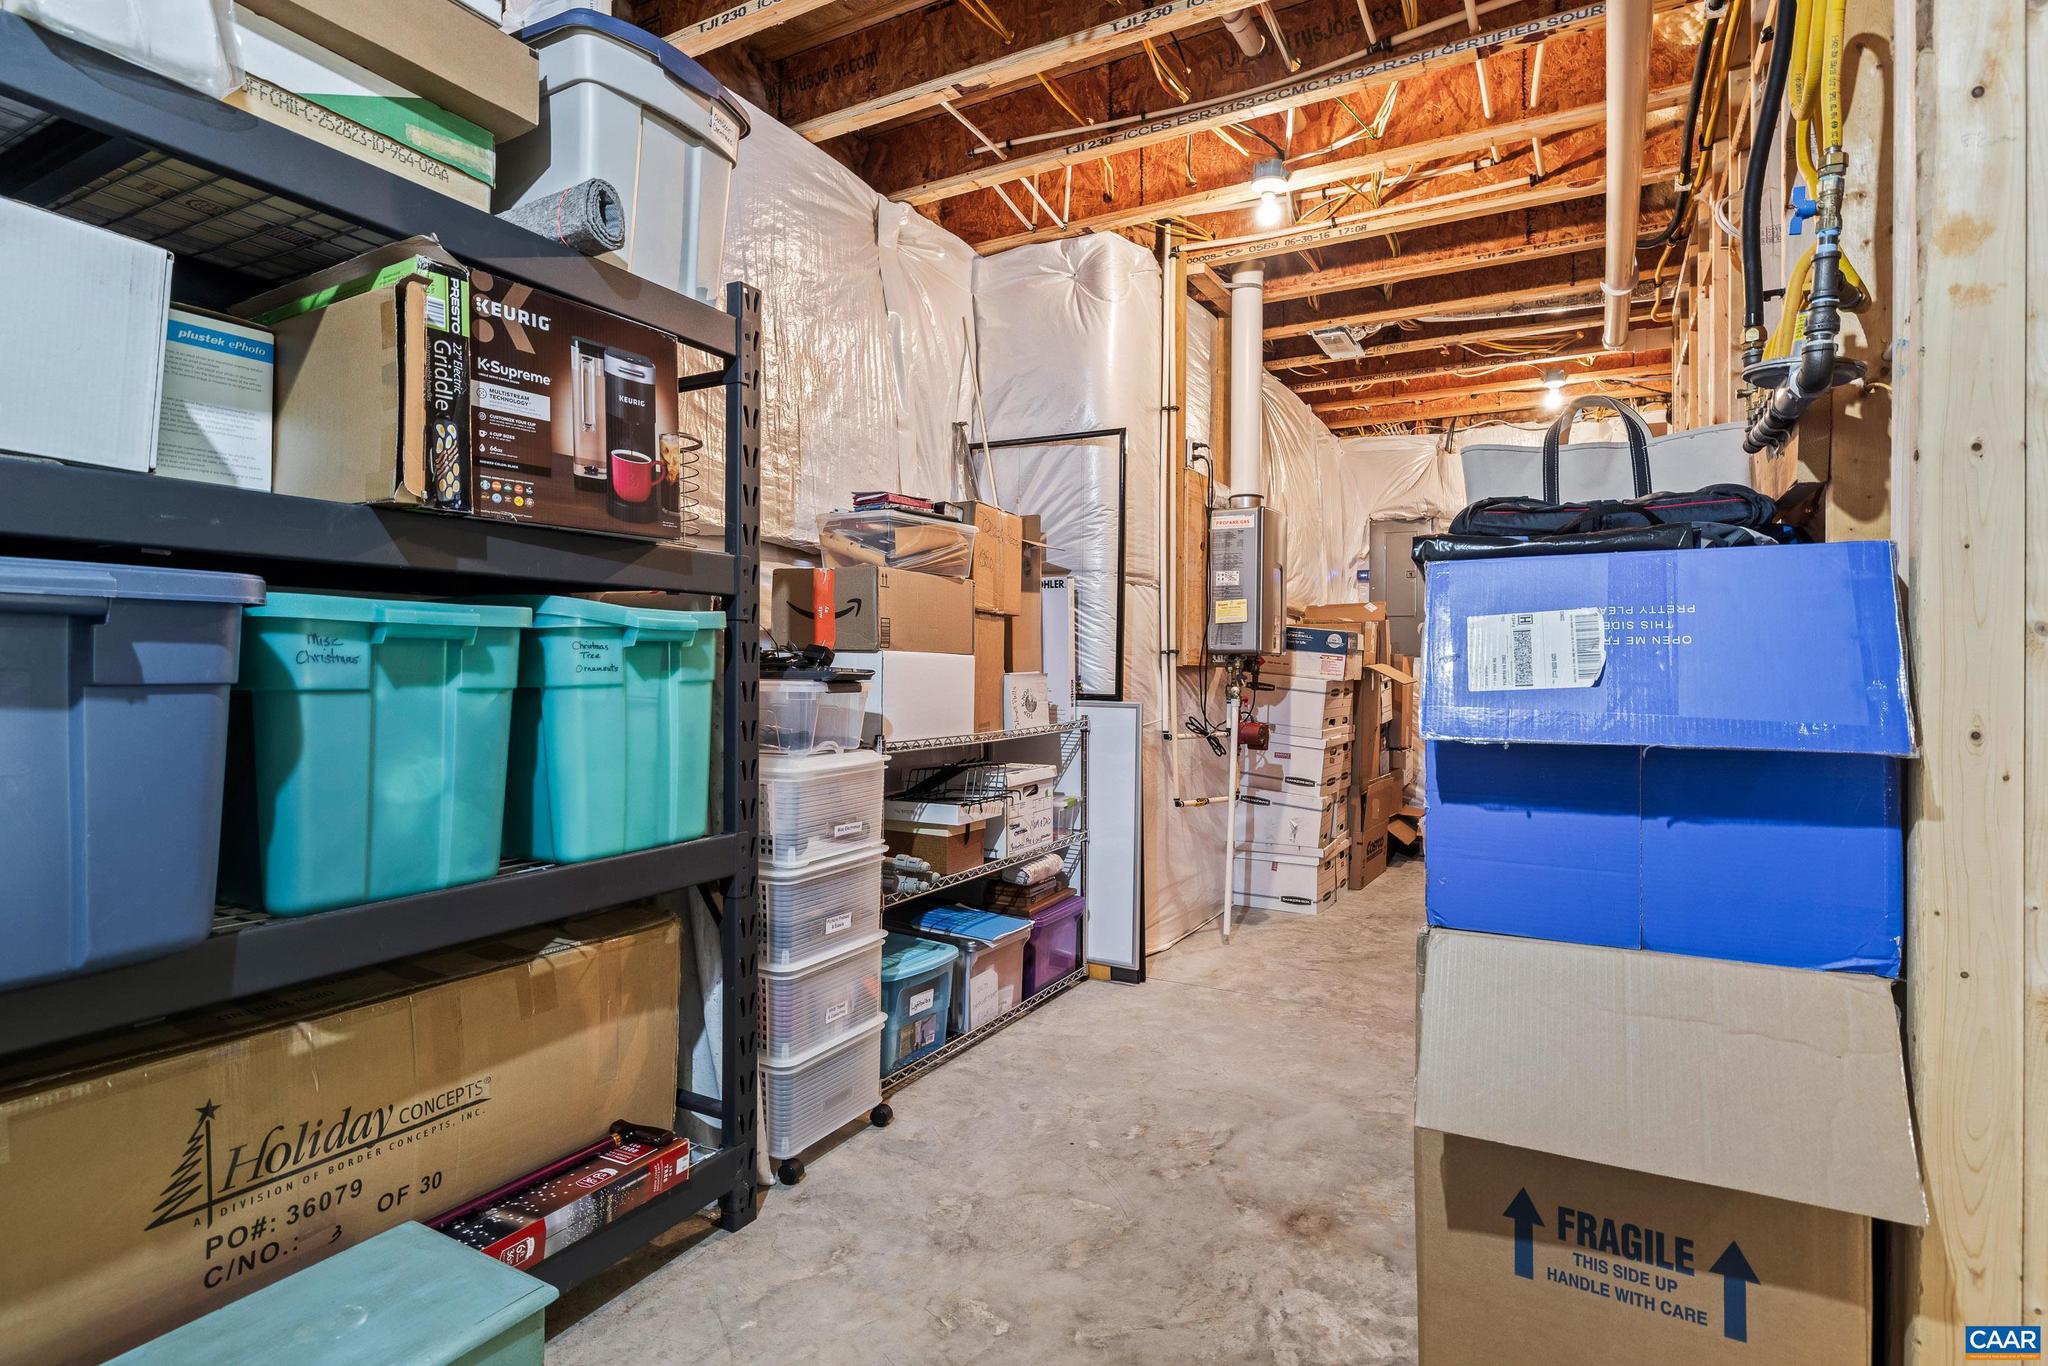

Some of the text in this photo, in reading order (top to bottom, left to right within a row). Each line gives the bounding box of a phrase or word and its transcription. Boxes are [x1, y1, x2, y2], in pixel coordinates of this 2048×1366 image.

[721, 6, 747, 25] 230
[1140, 4, 1173, 23] 230
[1063, 142, 1085, 155] TJI
[1087, 136, 1113, 149] 230
[1123, 120, 1172, 141] ICCES
[1176, 97, 1256, 127] ESR-1153
[1264, 79, 1320, 102] CCMC
[1322, 60, 1397, 88] 13132-R
[1440, 22, 1541, 55] CERTIFIED
[1546, 5, 1607, 28] SOUR
[1284, 231, 1331, 246] 06-30-16
[449, 276, 461, 335] PRESTO
[475, 296, 551, 332] KEURIG
[178, 329, 266, 356] plustek ePhoto
[433, 339, 454, 411] Griddle
[453, 361, 463, 397] Electric
[489, 388, 530, 401] MULTISTREAM
[489, 394, 529, 406] TECHNOLOGY
[618, 394, 646, 407] KEURIG
[1041, 579, 1065, 589] HLER
[1599, 604, 1696, 615] PRETTY PLEA
[1604, 620, 1674, 630] THIS SIDE
[571, 640, 609, 651] Christmas
[1604, 635, 1692, 645] OPEN ME FR
[295, 647, 360, 665] Christmas
[579, 651, 601, 660] Tree
[575, 663, 619, 673] Ornaments
[217, 1104, 395, 1194] Holiday
[193, 1108, 486, 1228] A DIVISION OF BORDER CONCEPTS, INC.
[205, 1178, 363, 1260] PO#: 36079
[203, 1171, 443, 1290] C/NO.: 3 OF 30
[1557, 1205, 1696, 1277] FRAGILE
[1573, 1252, 1678, 1293] THIS SIDE UP
[1547, 1267, 1708, 1326] HANDLE WITH CARE
